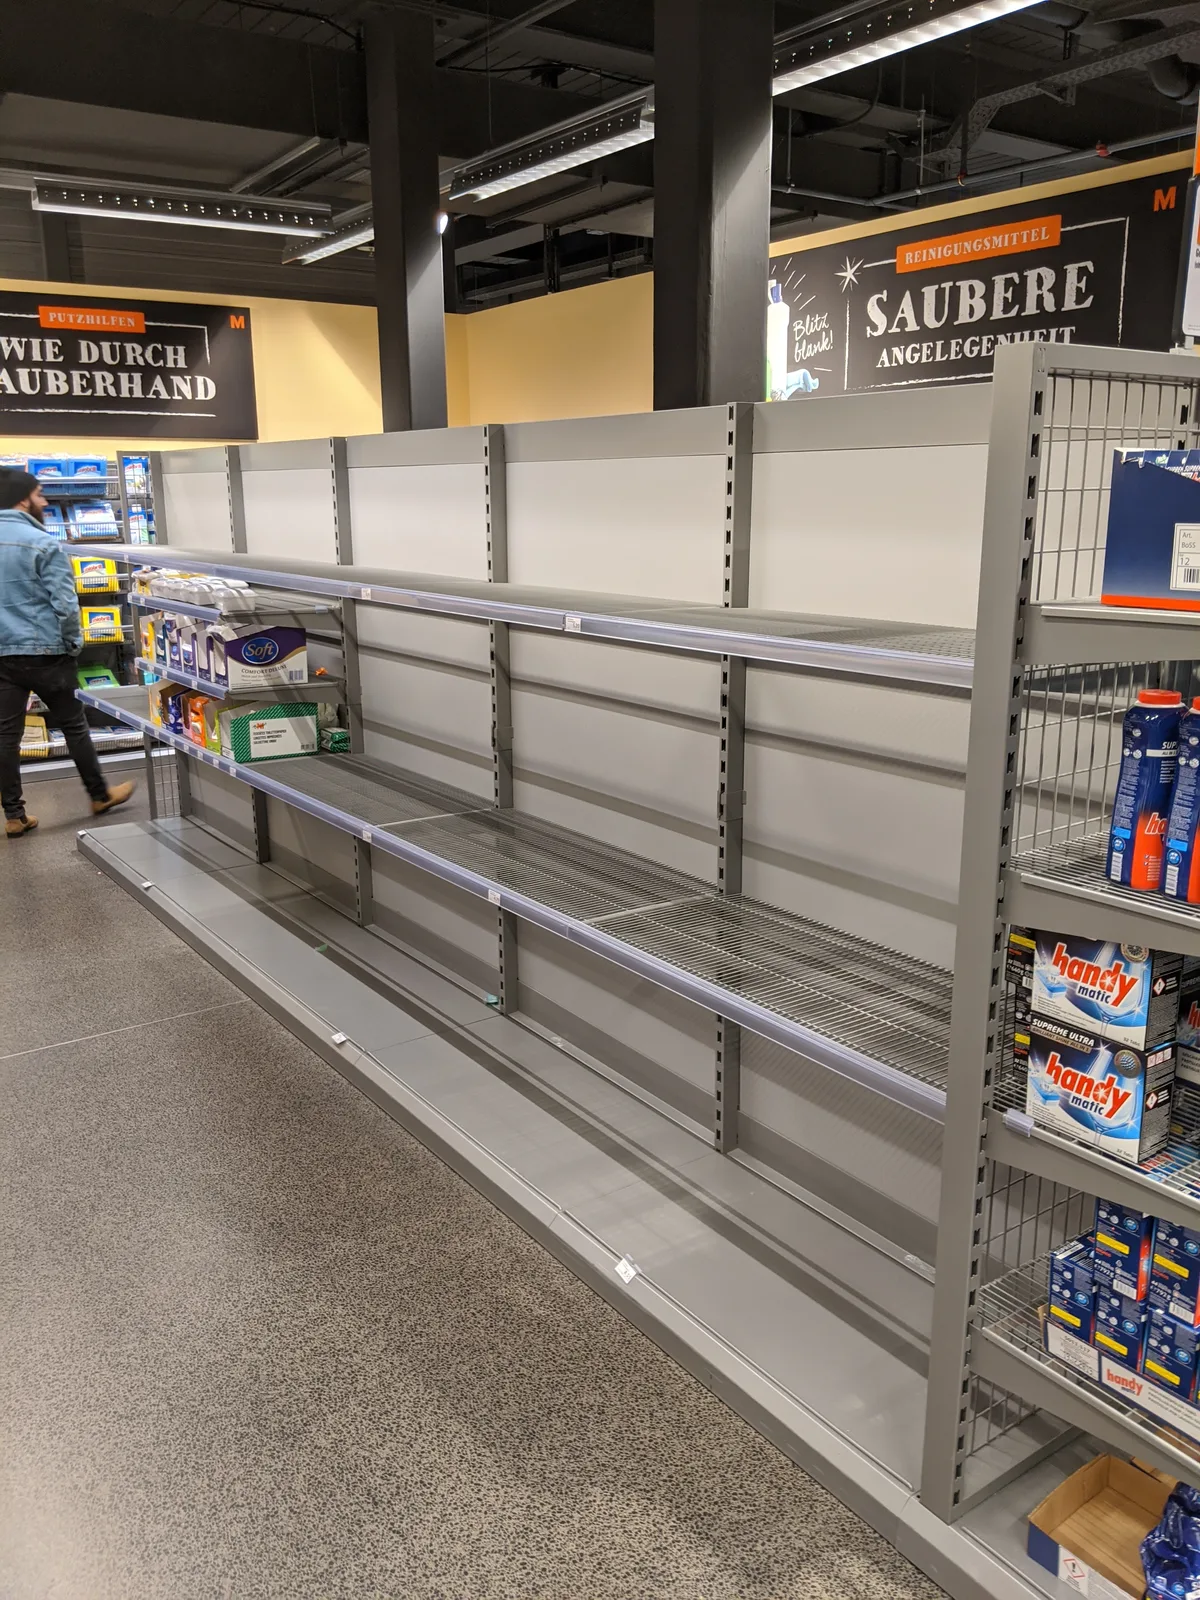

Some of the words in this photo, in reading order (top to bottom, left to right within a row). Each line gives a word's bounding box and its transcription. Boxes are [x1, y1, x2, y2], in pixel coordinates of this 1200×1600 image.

[904, 226, 1050, 266] REINIGUNGSMITTEL
[866, 261, 1095, 339] SAUBERE
[48, 311, 136, 328] PUTZHILFEN
[792, 312, 829, 342] Blitz
[0, 336, 64, 362] WIE
[79, 339, 188, 369] DURCH
[794, 329, 834, 363] blank!
[1180, 557, 1190, 566] 12
[245, 641, 275, 660] Soft
[1052, 943, 1139, 1007] handy
[1077, 984, 1111, 1004] matic
[1032, 1018, 1069, 1037] SUPREME
[1069, 1032, 1095, 1047] ULTRA
[1046, 1053, 1132, 1119] handy
[1071, 1094, 1105, 1115] matic
[1106, 1368, 1144, 1396] handy
